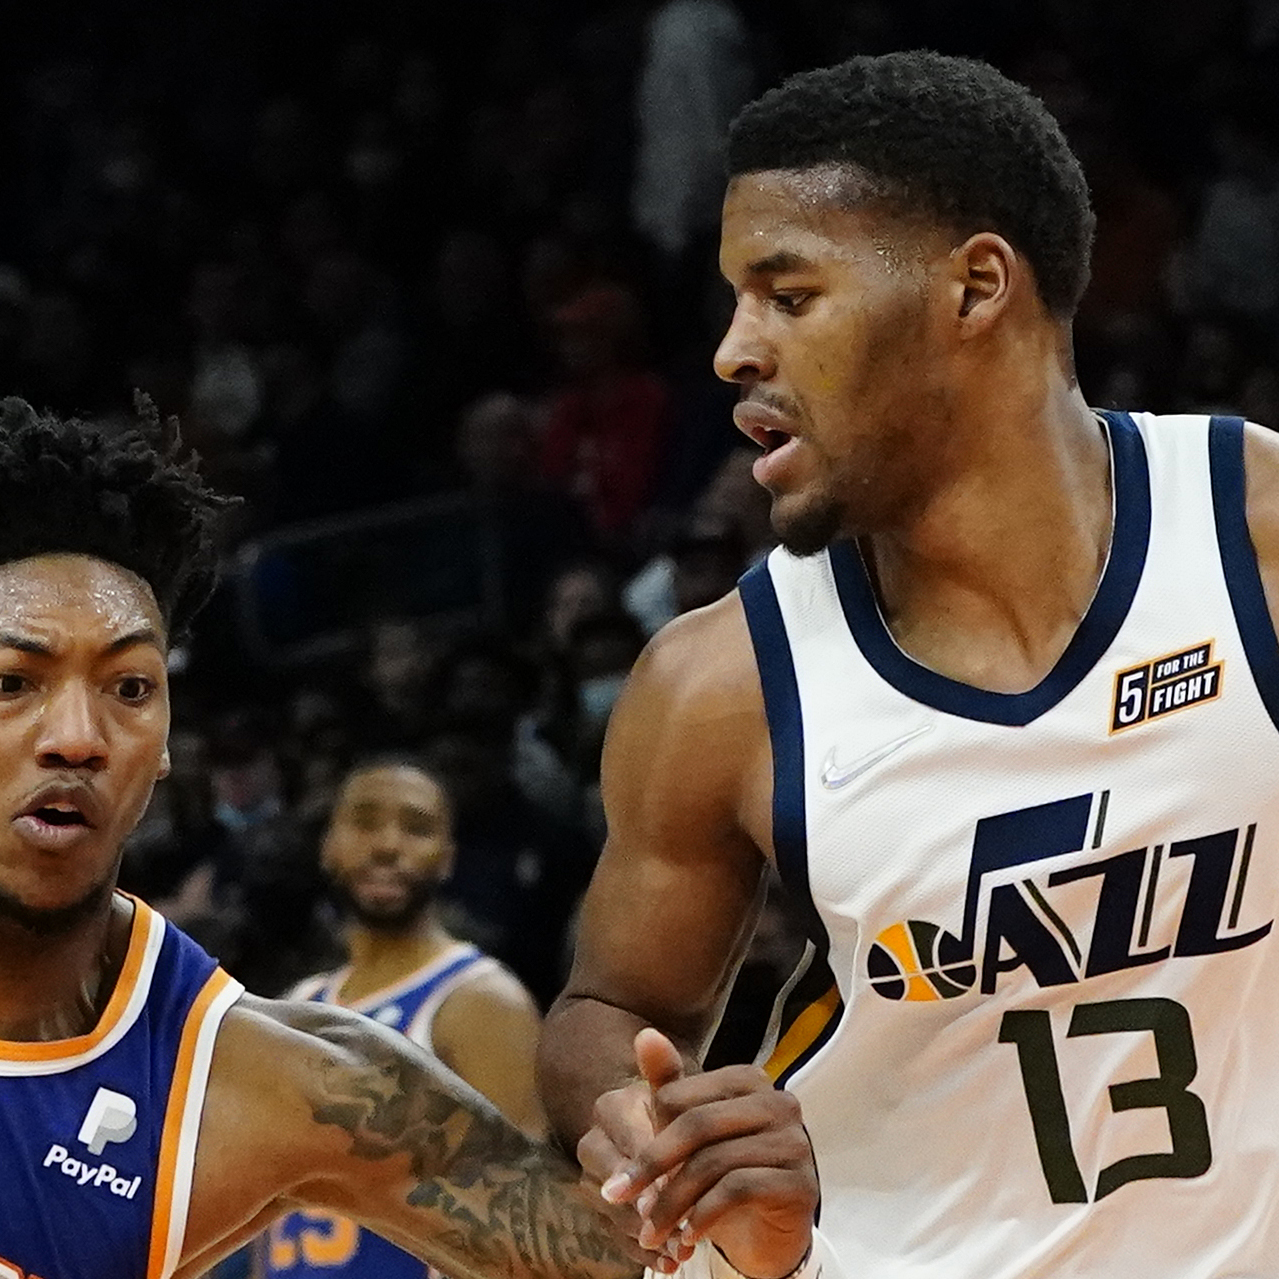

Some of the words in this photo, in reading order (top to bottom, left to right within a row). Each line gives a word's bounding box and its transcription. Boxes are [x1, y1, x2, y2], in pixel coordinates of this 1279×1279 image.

[1157, 659, 1180, 678] FOR
[1183, 650, 1205, 669] THE
[1119, 671, 1144, 723] 5
[1153, 671, 1215, 713] FIGHT
[867, 788, 1275, 1004] JAZZ
[997, 997, 1213, 1205] 13
[42, 1144, 142, 1199] PayPal
